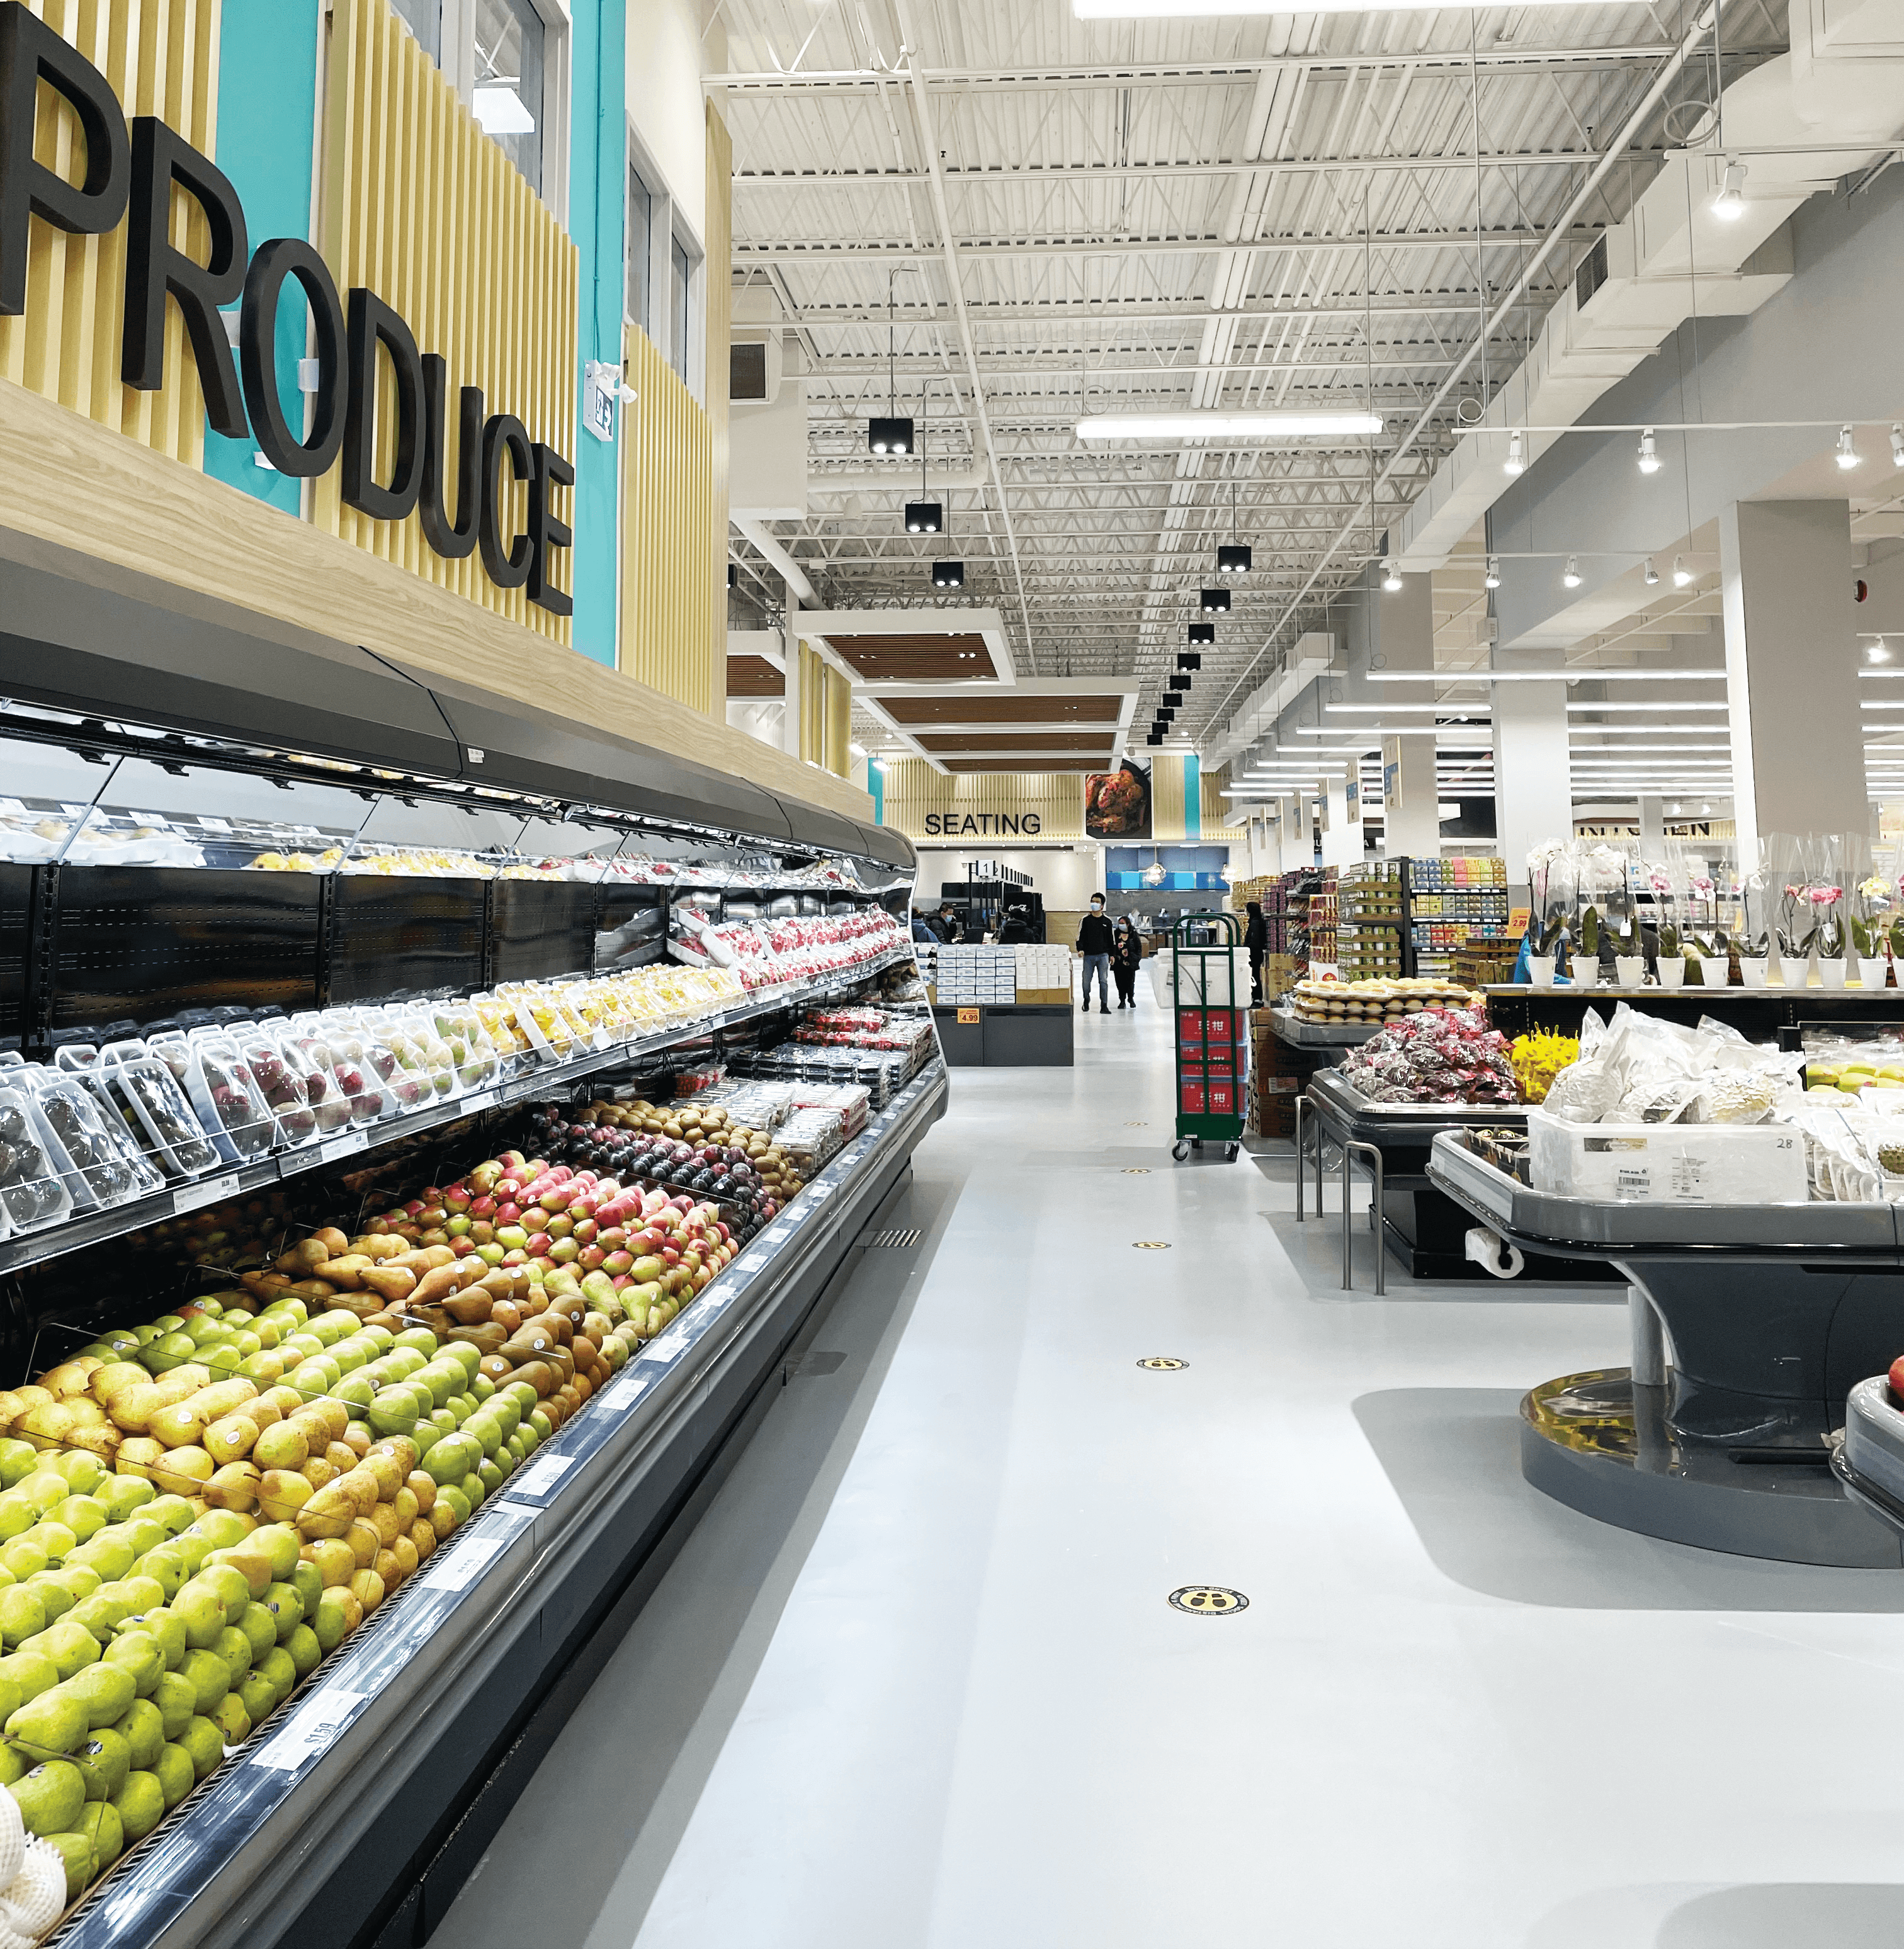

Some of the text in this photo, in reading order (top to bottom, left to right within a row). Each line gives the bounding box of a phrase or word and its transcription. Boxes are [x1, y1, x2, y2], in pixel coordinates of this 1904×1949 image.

[0, 0, 575, 616] PRODUCE
[925, 813, 1041, 835] SEATING
[983, 863, 988, 873] 1
[1777, 1138, 1793, 1148] 28
